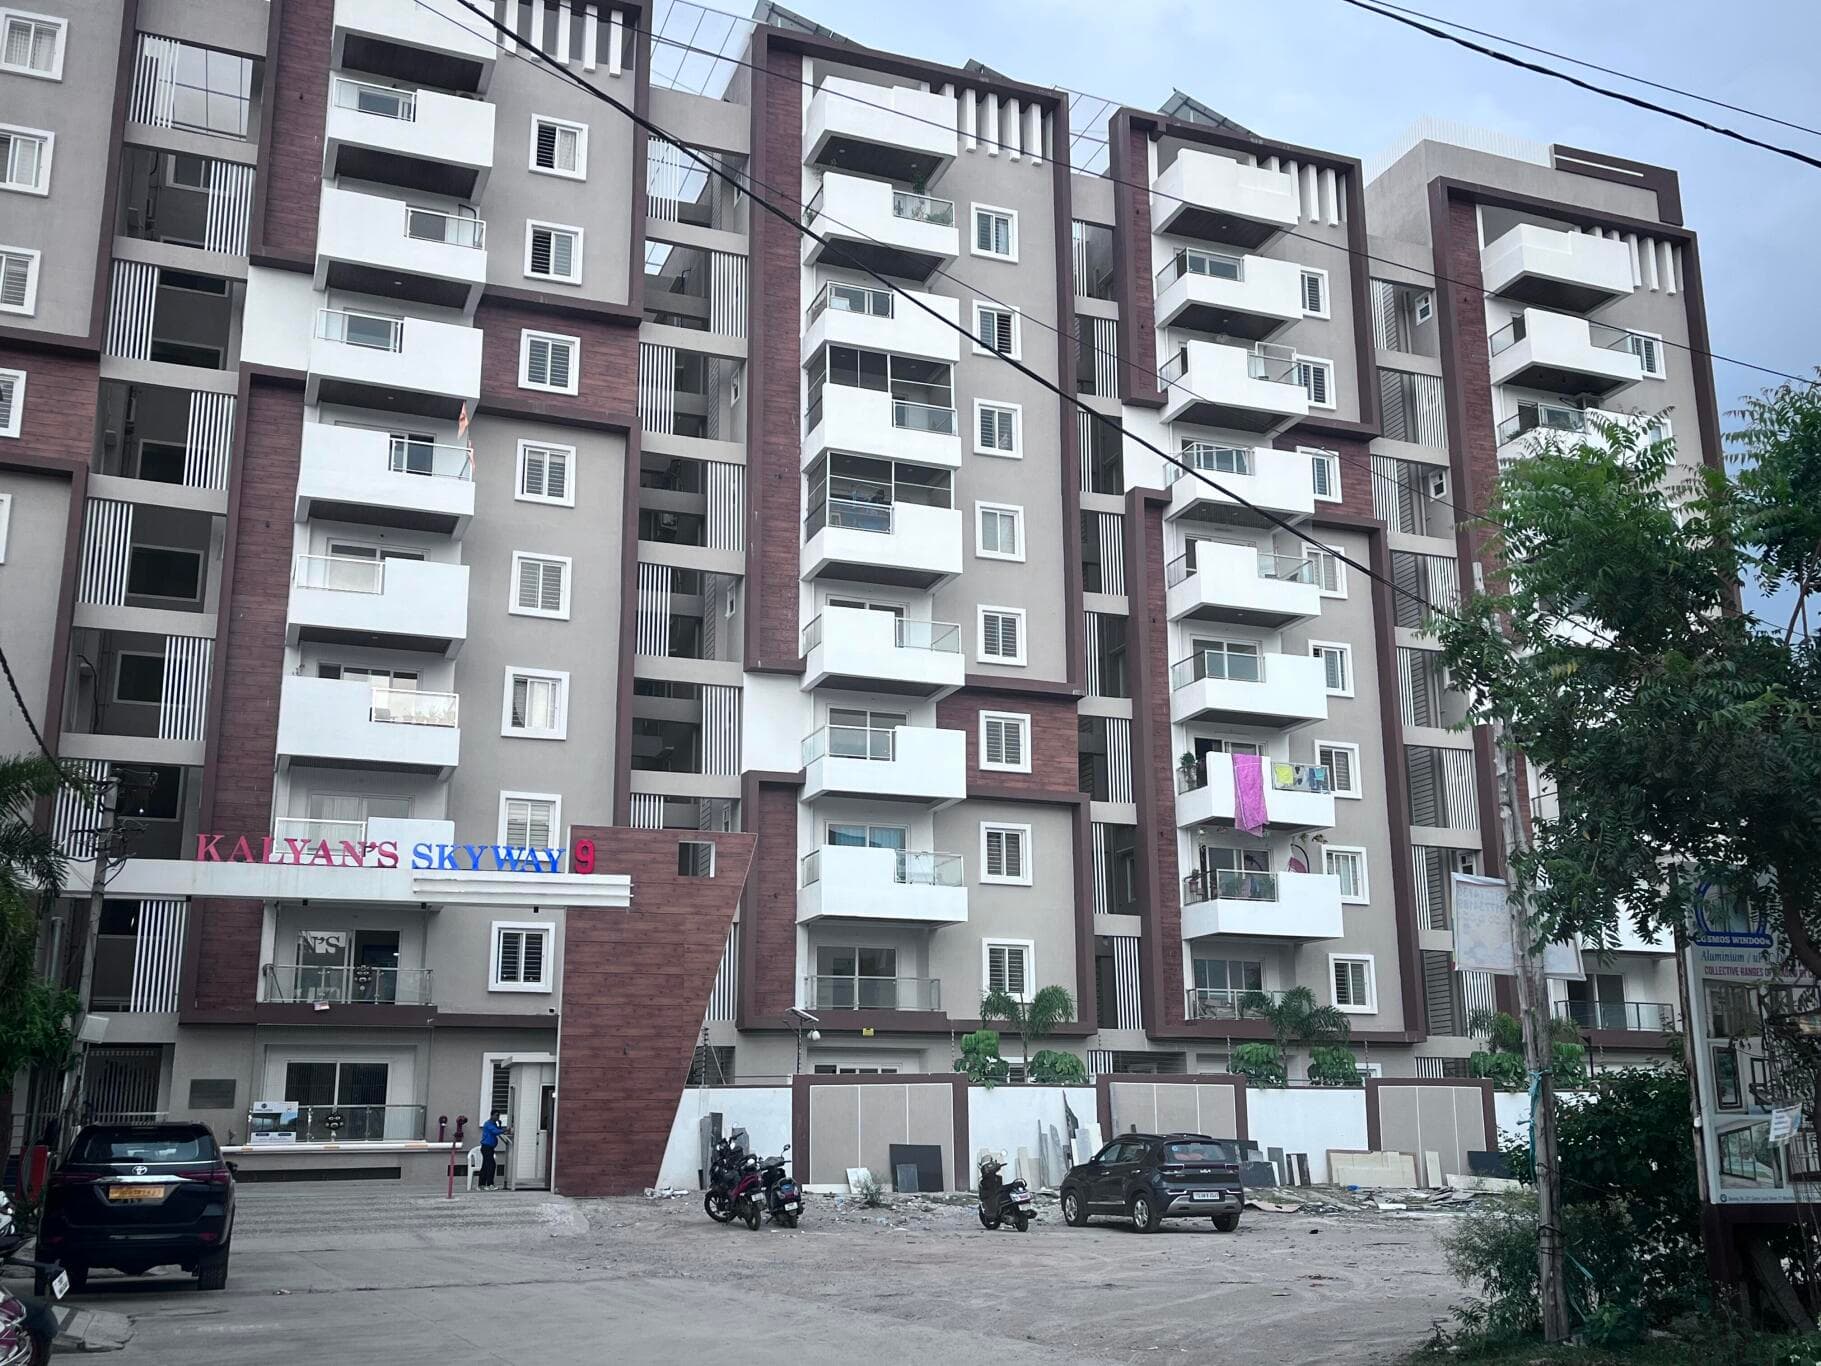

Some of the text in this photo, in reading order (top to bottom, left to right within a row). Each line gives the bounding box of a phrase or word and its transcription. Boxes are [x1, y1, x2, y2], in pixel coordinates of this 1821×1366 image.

[196, 833, 595, 874] KALYAN'S SKYWAY 9
[1705, 966, 1740, 976] COLLECTIVE
